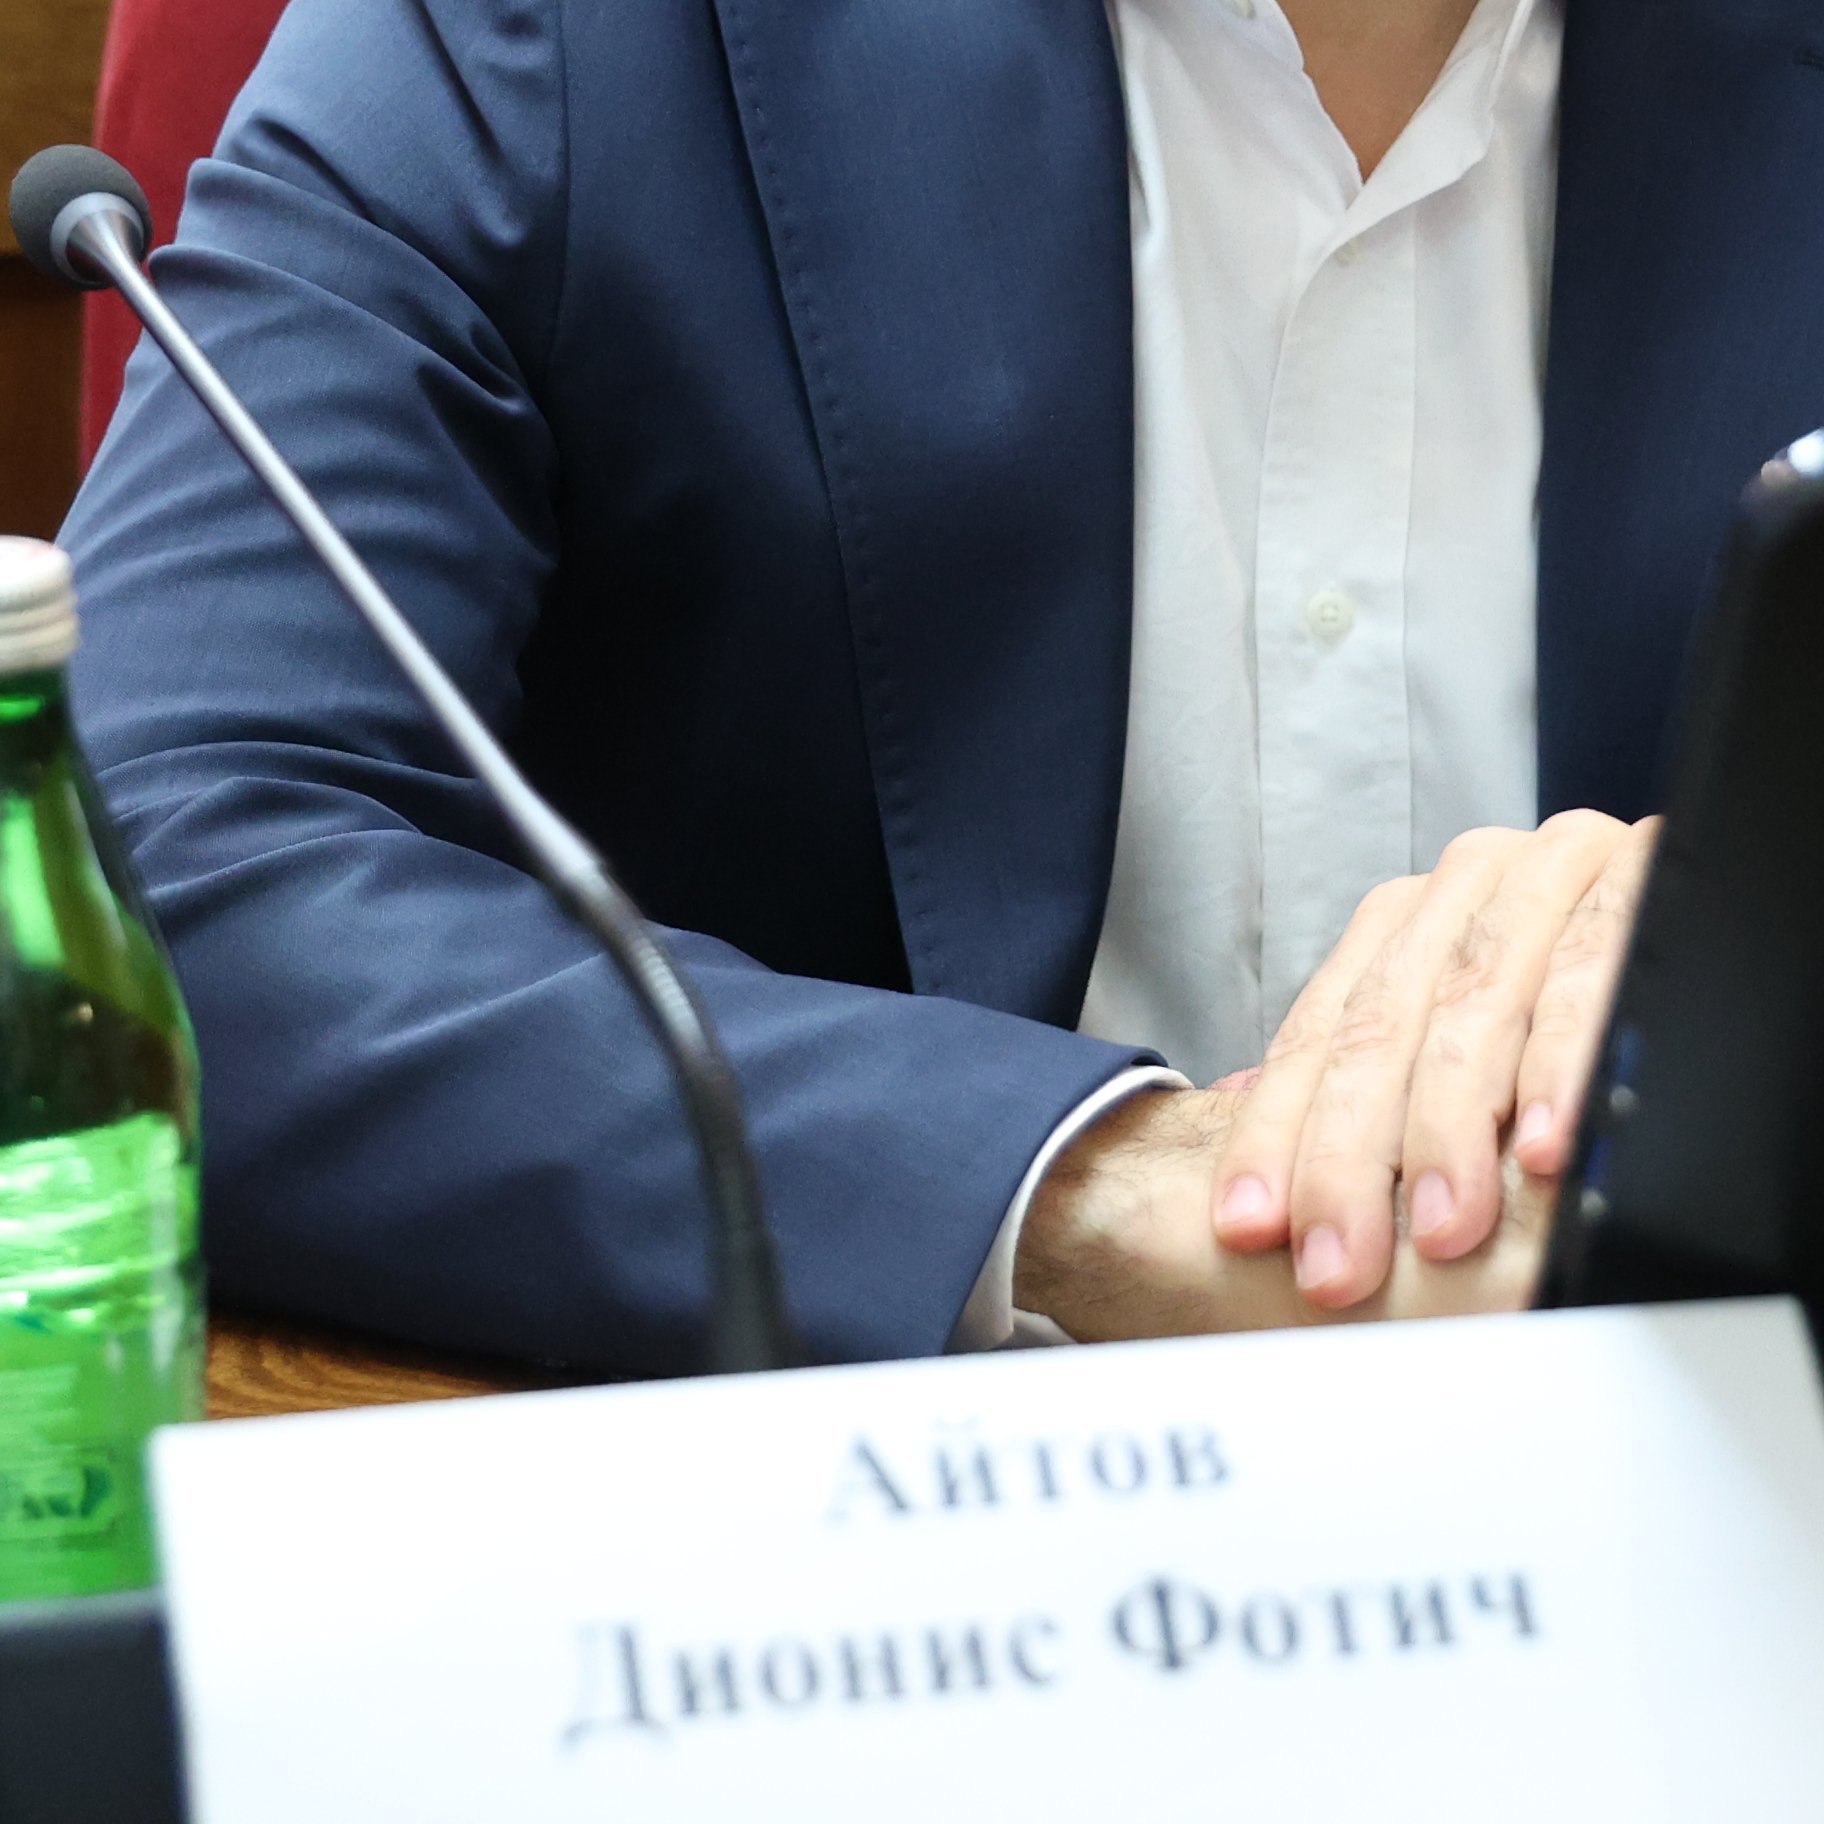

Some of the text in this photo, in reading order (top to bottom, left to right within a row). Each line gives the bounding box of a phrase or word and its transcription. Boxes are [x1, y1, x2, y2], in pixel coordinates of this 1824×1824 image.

[824, 1418, 1234, 1524] Айтов
[558, 1570, 1544, 1750] Дионис Фотич
